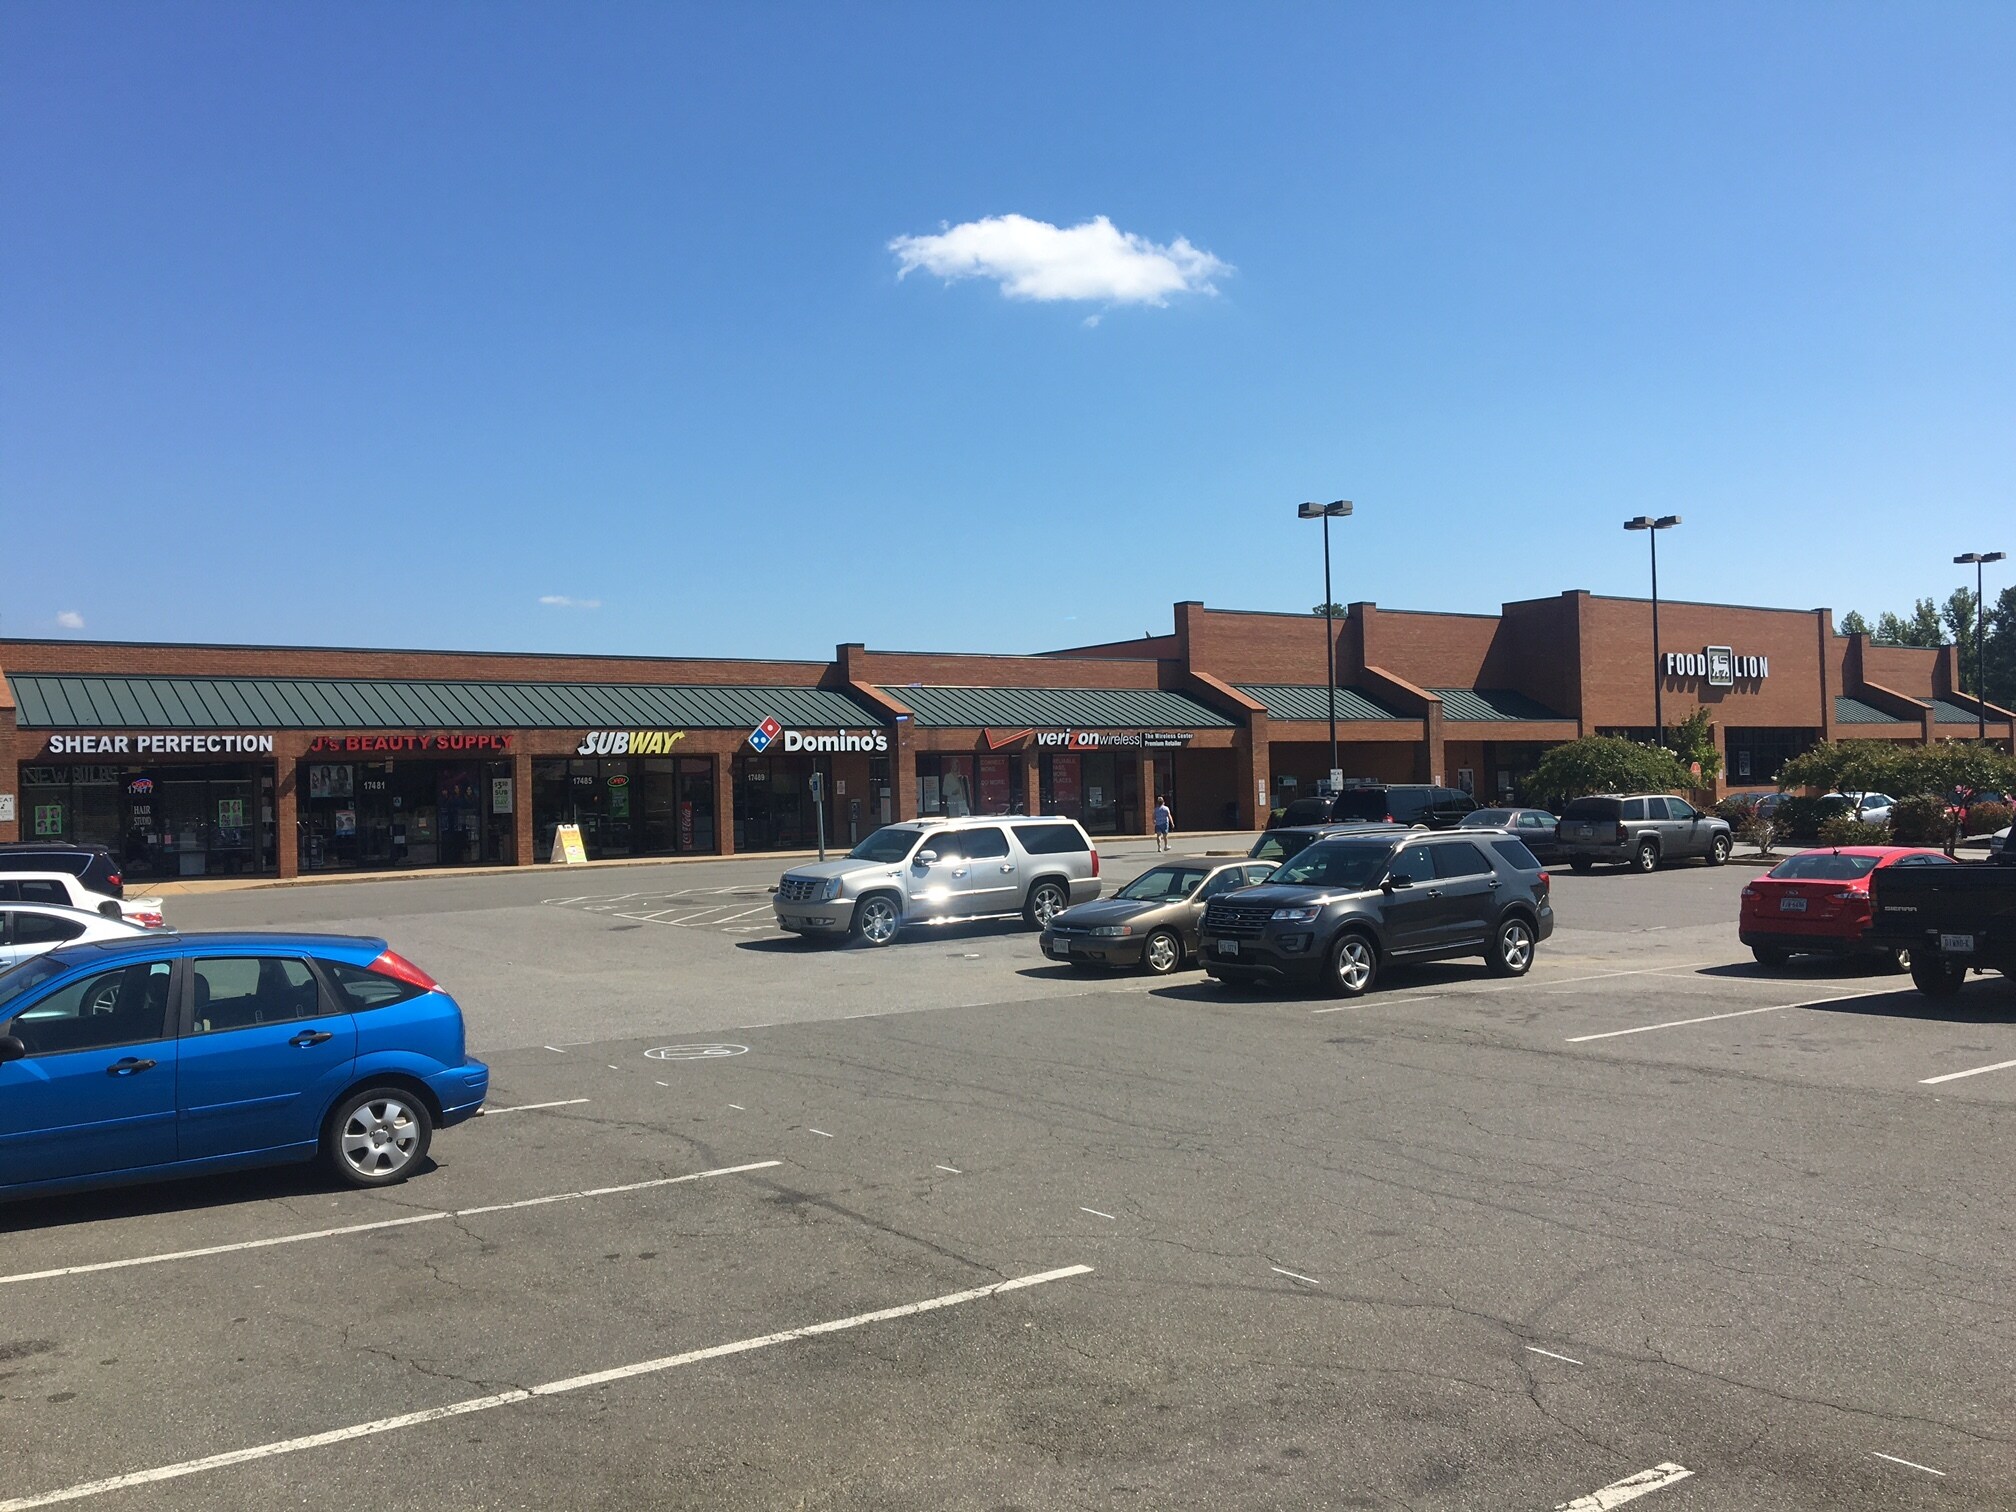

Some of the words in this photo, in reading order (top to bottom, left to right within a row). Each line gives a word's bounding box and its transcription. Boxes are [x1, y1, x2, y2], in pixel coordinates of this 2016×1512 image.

[1668, 654, 1706, 676] FOOD
[1735, 656, 1769, 677] LION
[49, 735, 129, 753] SHEAR
[138, 735, 273, 752] PERFECTION
[311, 736, 340, 752] J's
[346, 735, 431, 751] BEAUTY
[436, 734, 513, 750] SUPPLY
[577, 730, 686, 756] SUBWAY
[784, 729, 888, 752] Domino's
[1037, 729, 1099, 749] verizon
[1100, 732, 1140, 745] wireless
[22, 766, 69, 783] NEW
[573, 777, 592, 785] 17485
[128, 785, 153, 794] 17477
[363, 781, 385, 790] 17481
[133, 805, 151, 814] HAIR
[133, 816, 151, 826] STUDIO
